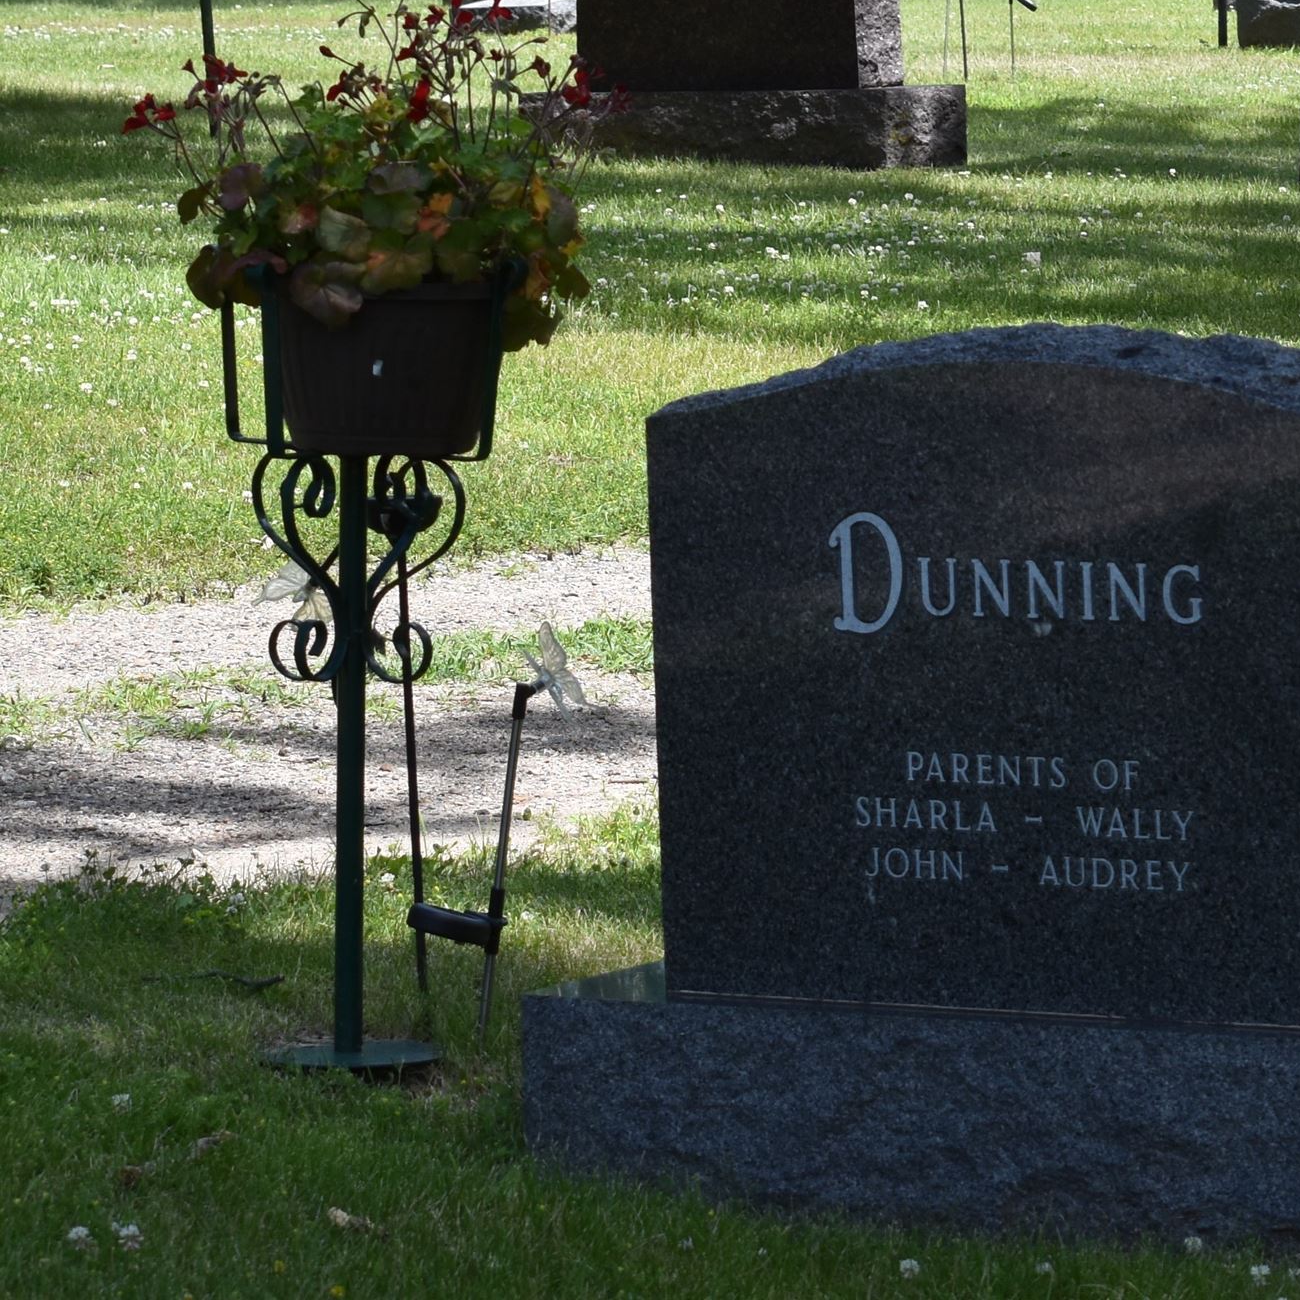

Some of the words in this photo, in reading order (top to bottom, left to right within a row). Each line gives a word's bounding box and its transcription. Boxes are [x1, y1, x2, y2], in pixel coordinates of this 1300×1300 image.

[906, 751, 1069, 788] PARENTS
[1093, 759, 1140, 790] OF
[855, 796, 998, 833] SHARLA
[1076, 806, 1195, 841] WALLY
[865, 847, 964, 881] JOHN
[1039, 855, 1191, 892] AUDREY
